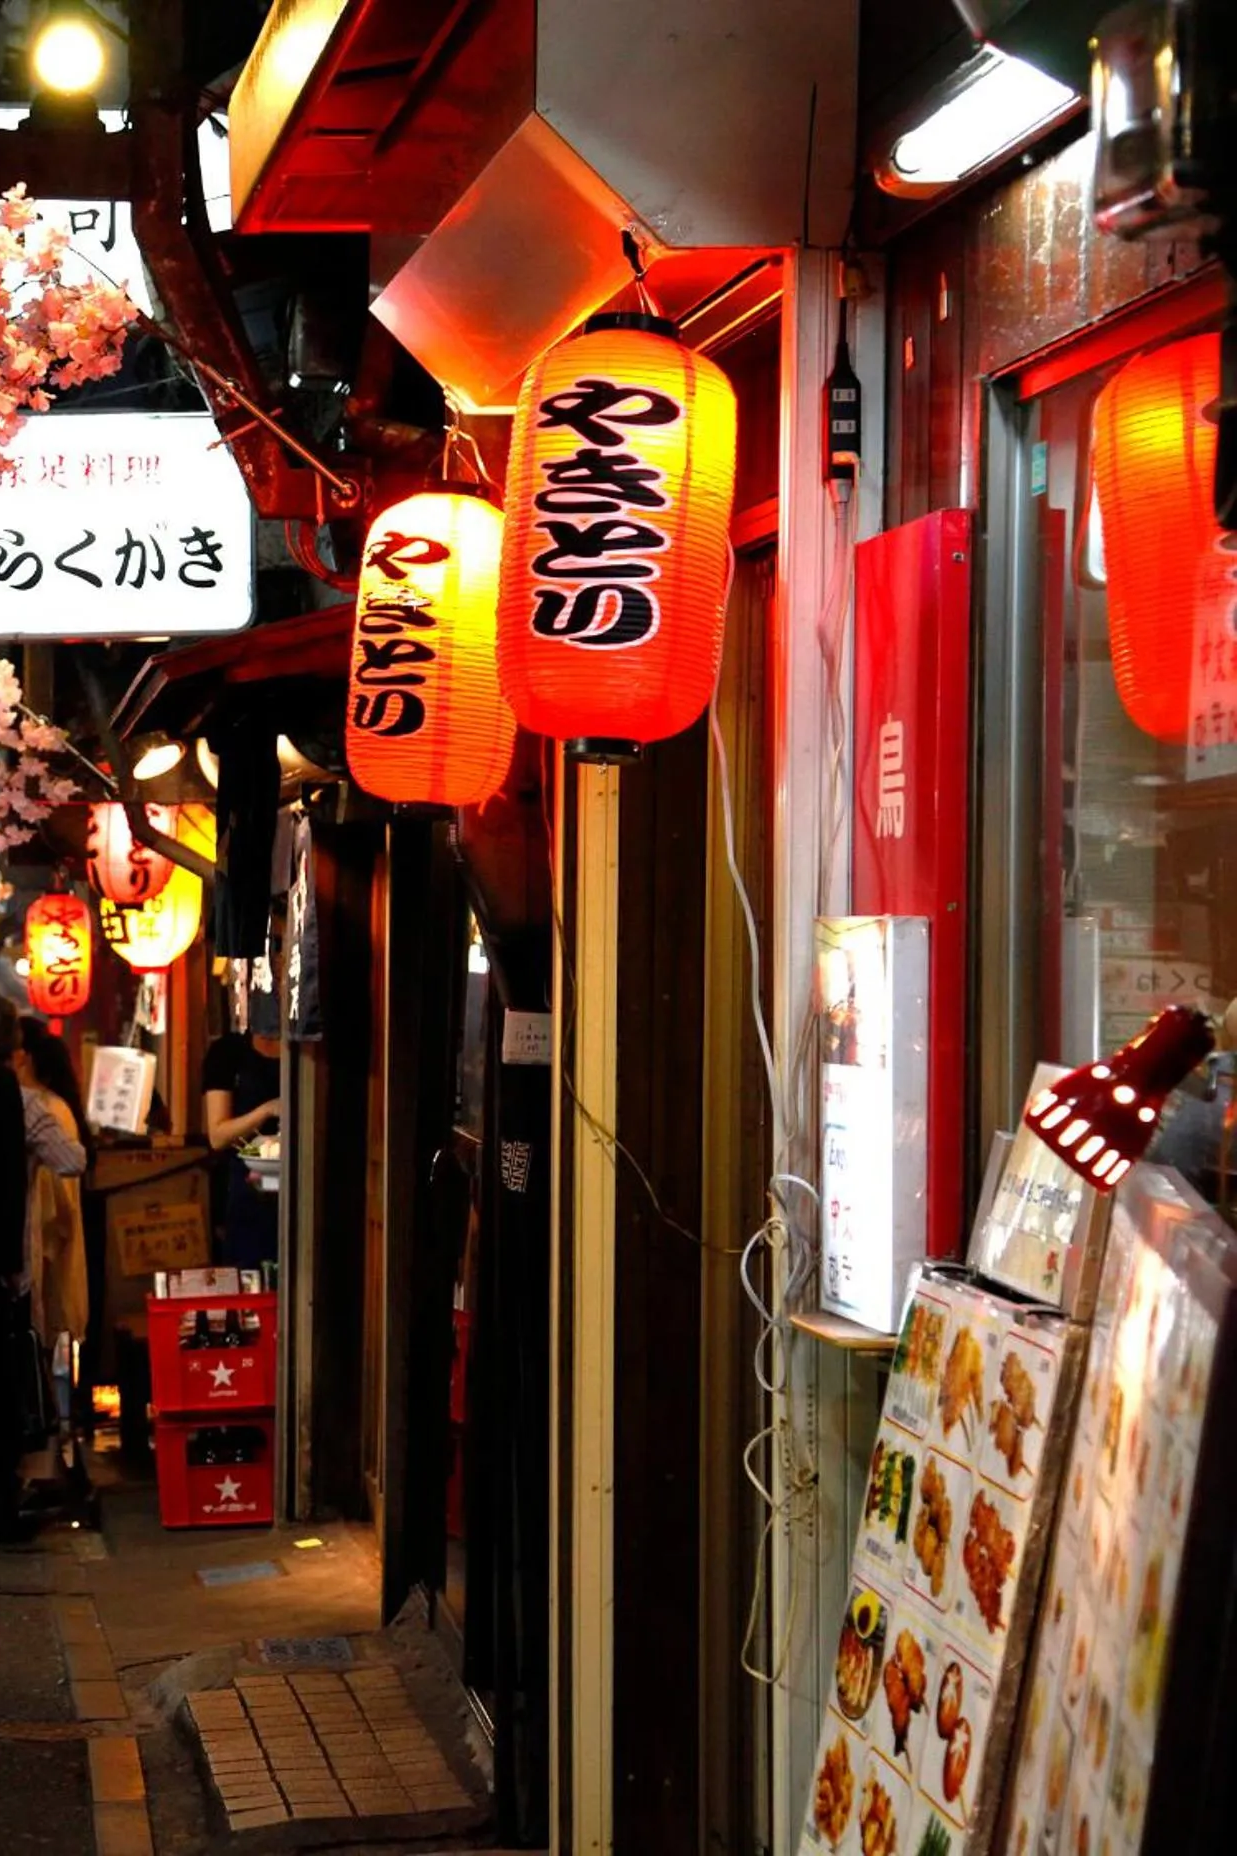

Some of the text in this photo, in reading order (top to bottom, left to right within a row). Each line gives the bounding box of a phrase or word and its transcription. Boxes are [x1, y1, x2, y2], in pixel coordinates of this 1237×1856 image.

[532, 380, 680, 645] やきとり
[355, 531, 451, 738] やきとり
